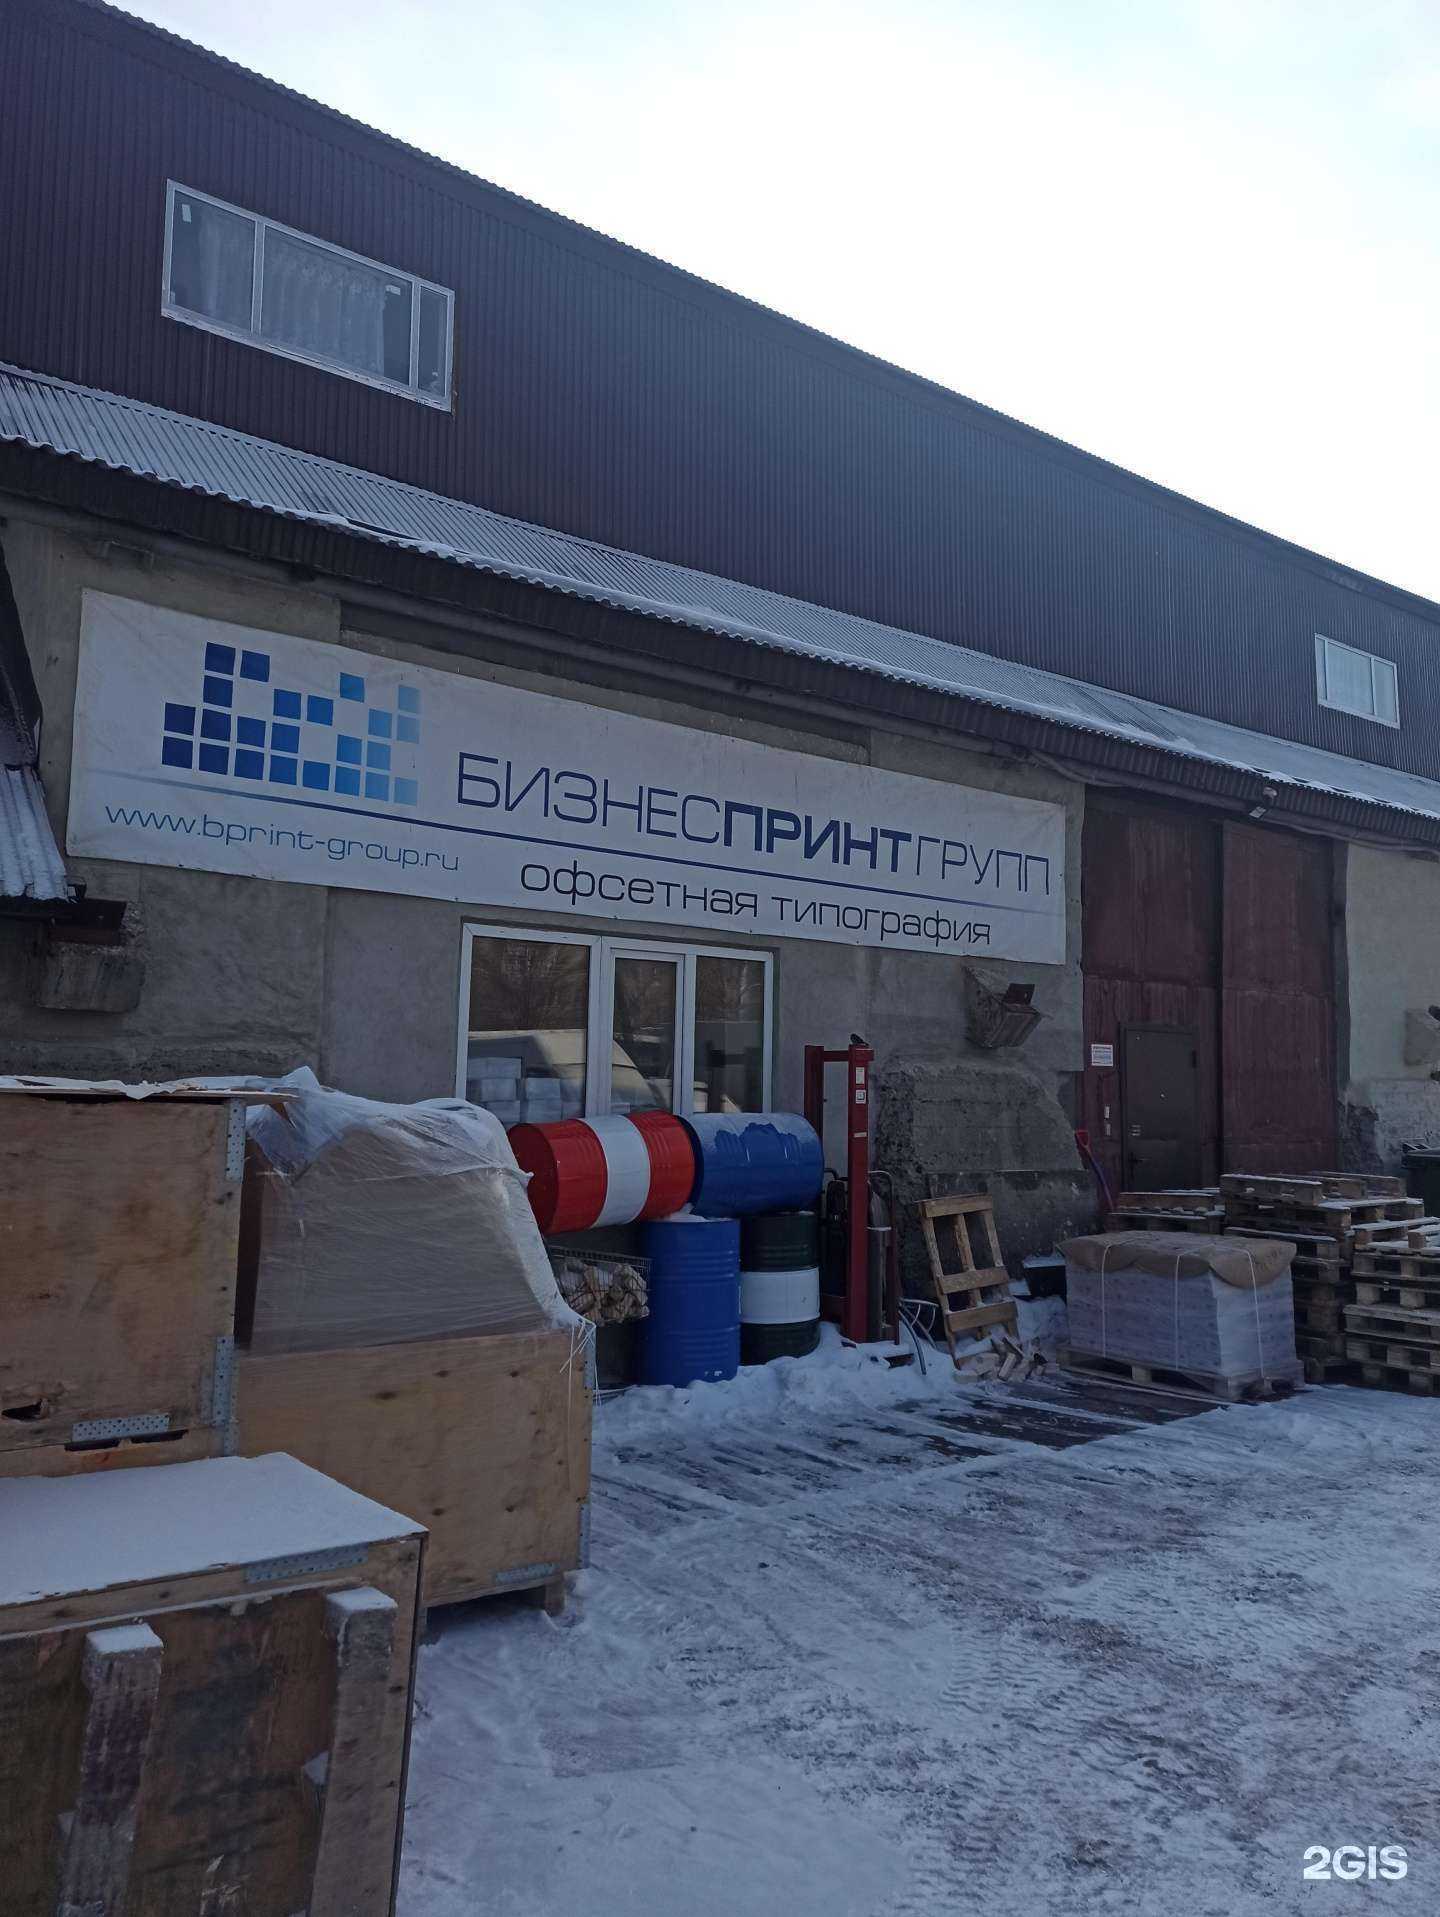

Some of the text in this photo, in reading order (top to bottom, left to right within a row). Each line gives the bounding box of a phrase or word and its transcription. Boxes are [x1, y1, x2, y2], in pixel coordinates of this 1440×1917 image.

[105, 805, 459, 872] www.bprint-group.ru
[458, 752, 1051, 896] БИЗНЕСПРИНТГРУПП
[521, 860, 991, 945] офсетная типография
